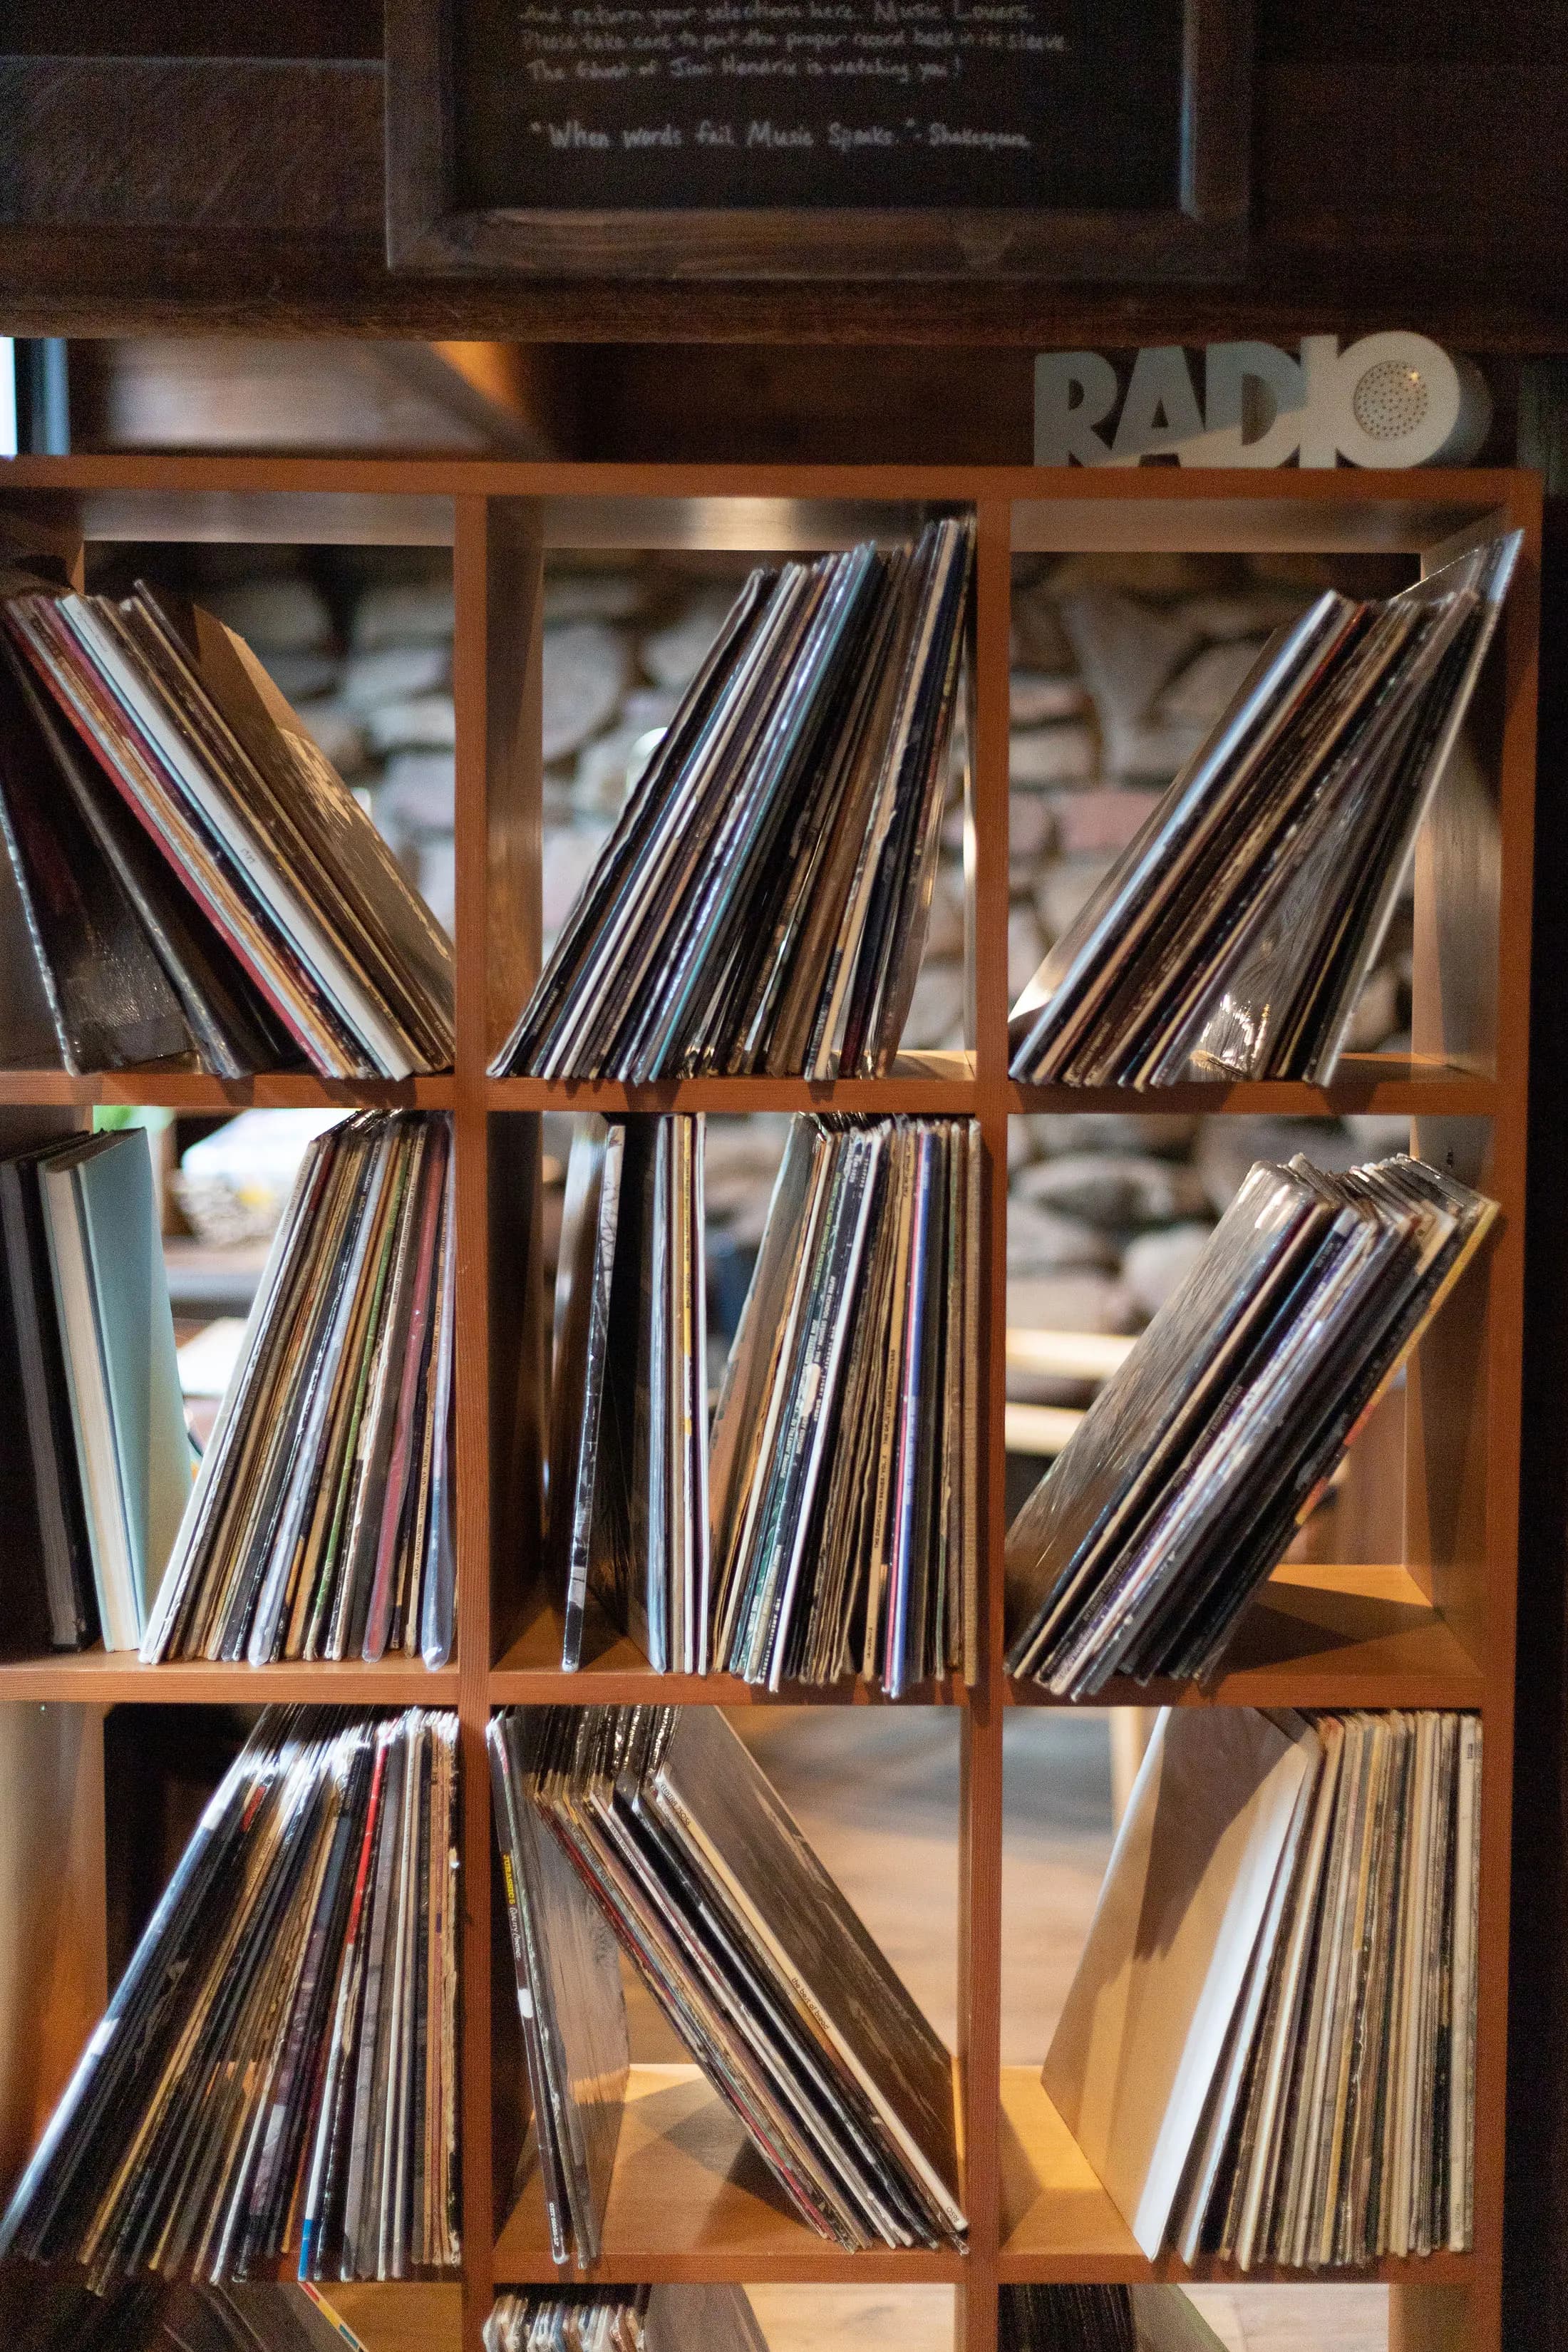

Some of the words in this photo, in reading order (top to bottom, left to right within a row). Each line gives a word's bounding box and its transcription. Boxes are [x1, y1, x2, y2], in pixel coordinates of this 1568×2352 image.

[622, 123, 682, 150] words
[695, 120, 736, 147] fail
[747, 120, 813, 148] Music
[1033, 331, 1460, 468] RADIO
[401, 1214, 411, 1243] BROTHERS
[821, 1294, 832, 1319] SCHOOL
[767, 1614, 778, 1646] AMERICA
[659, 1783, 679, 1807] ELEKTRA
[675, 1805, 692, 1826] 75056
[502, 1854, 515, 1898] JURASSIC
[791, 1976, 802, 1989] the
[798, 1988, 812, 2004] best
[808, 2002, 817, 2011] of
[813, 2010, 830, 2031] bread
